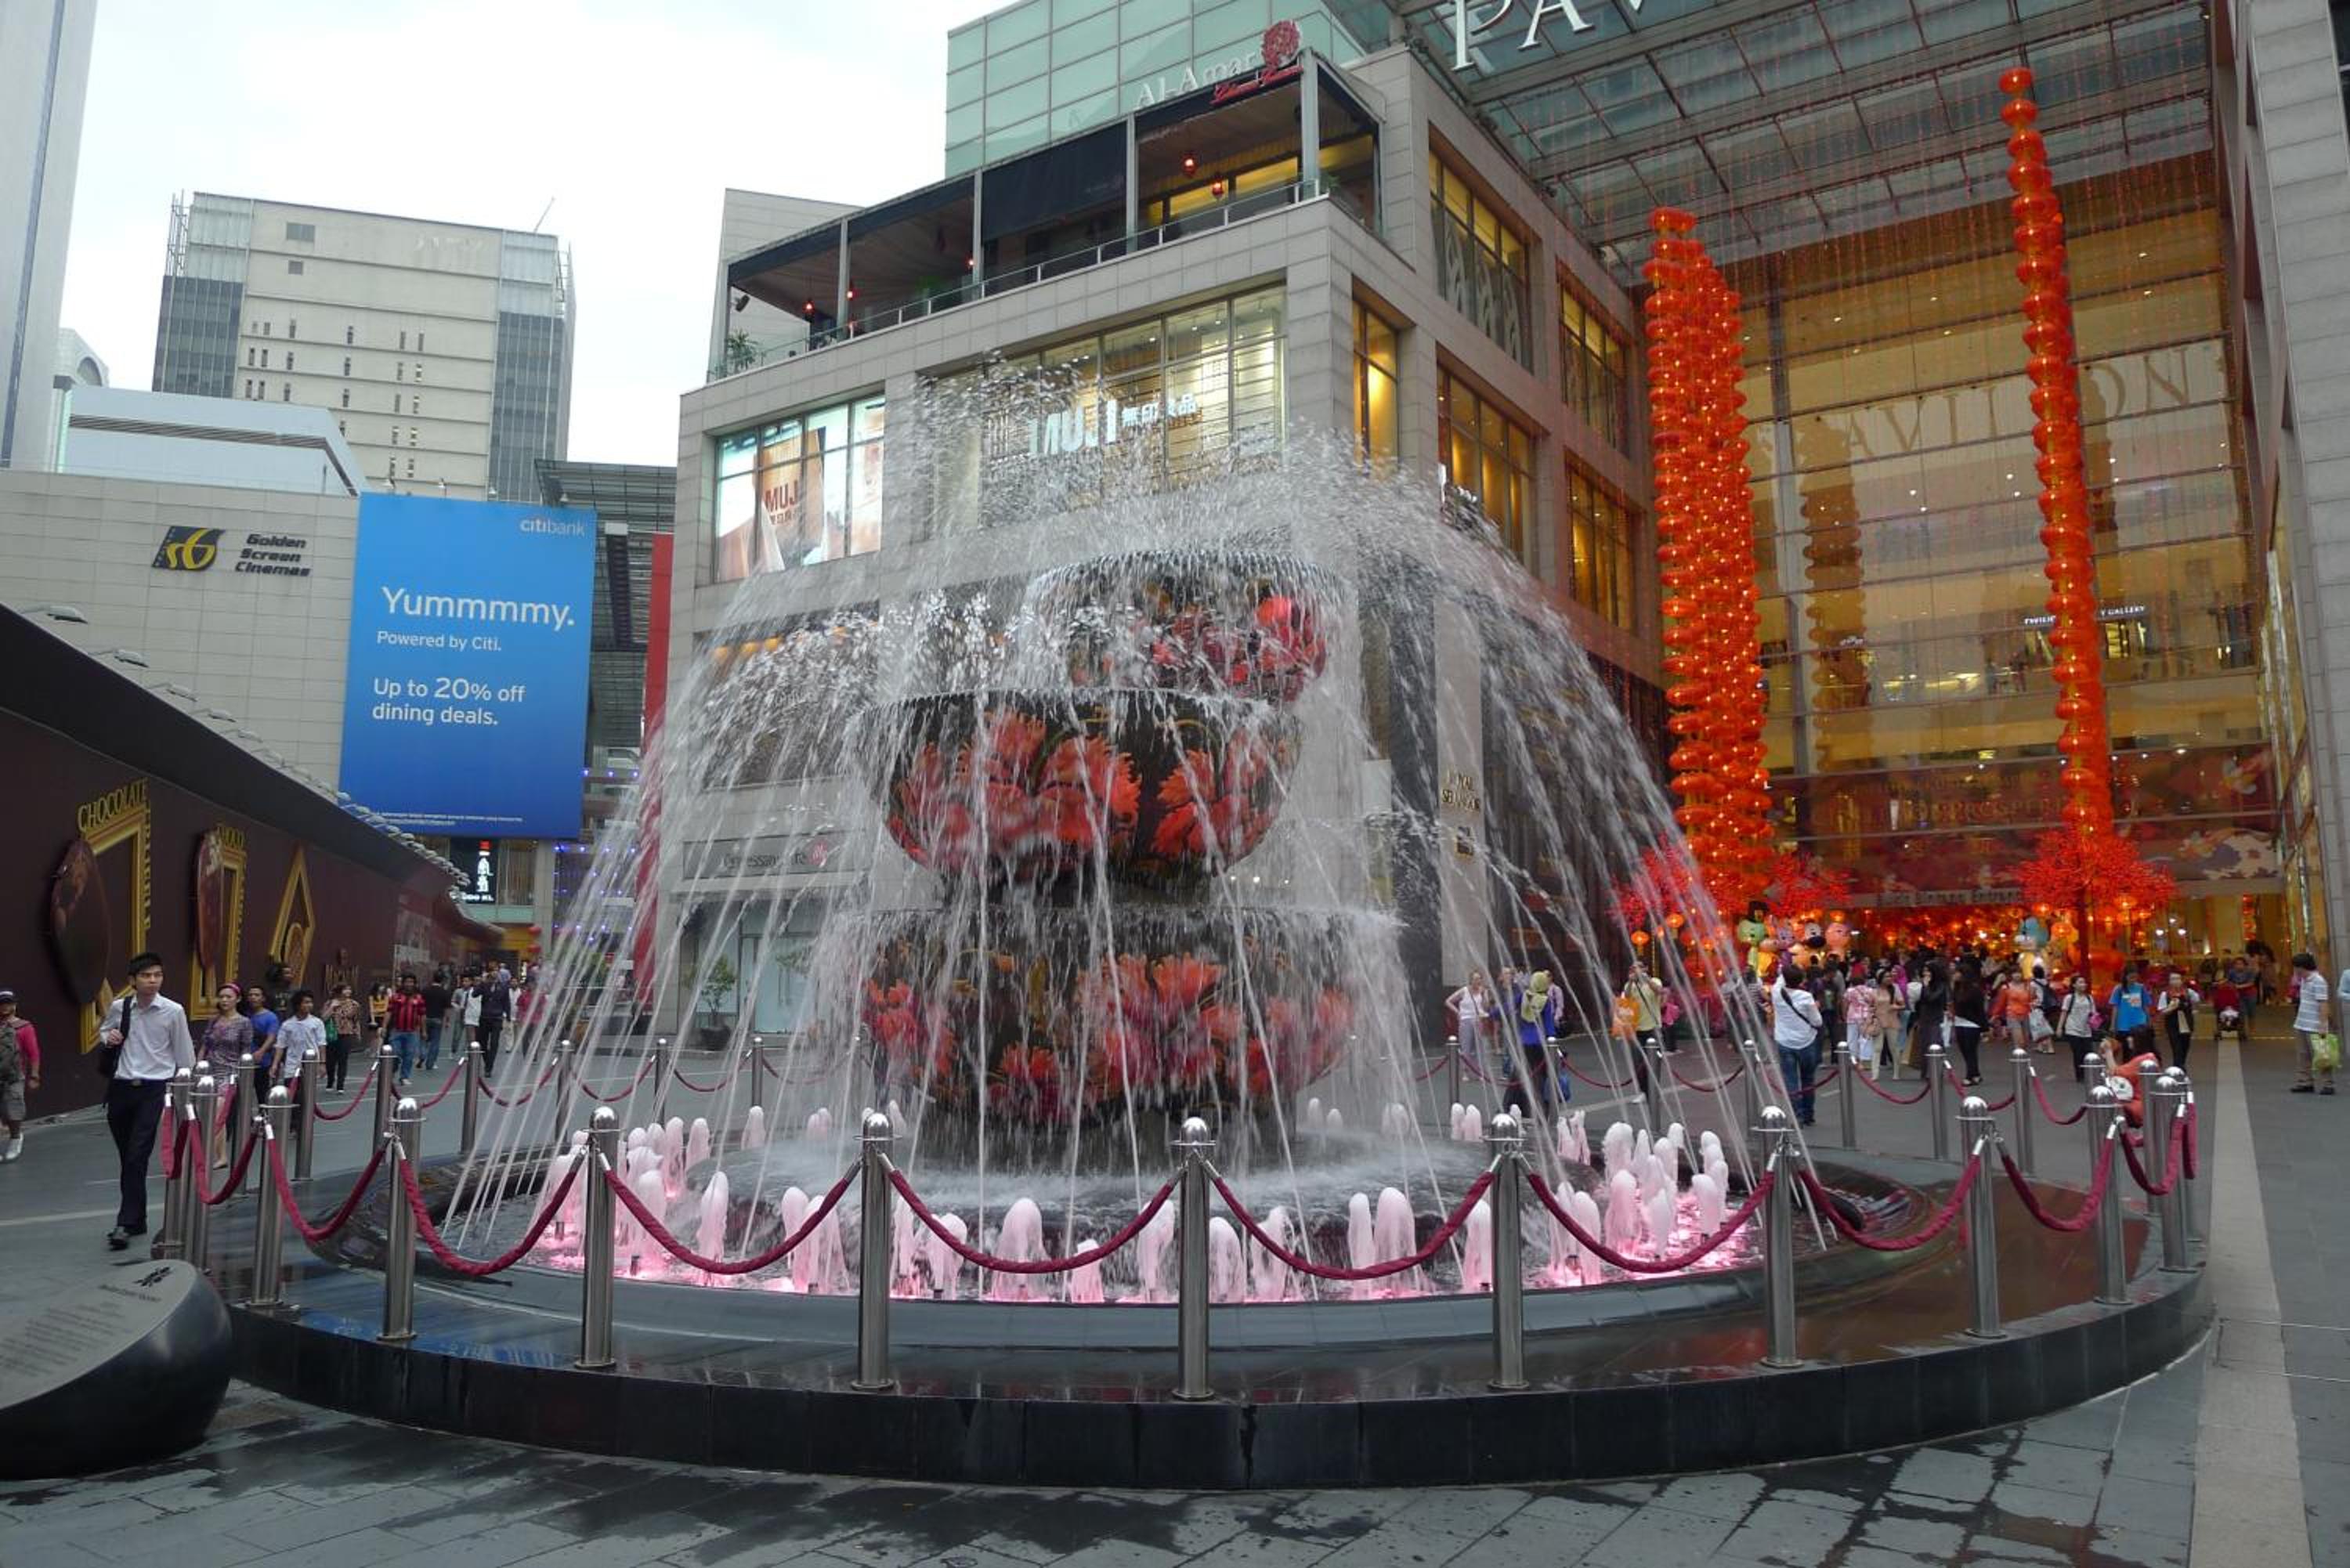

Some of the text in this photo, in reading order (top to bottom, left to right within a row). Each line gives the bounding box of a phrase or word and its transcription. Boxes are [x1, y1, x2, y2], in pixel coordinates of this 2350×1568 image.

[520, 518, 585, 537] citibank
[247, 533, 307, 549] Golden
[240, 547, 302, 562] Screen
[235, 561, 311, 577] Cinemas
[381, 586, 575, 631] Yummmmy.
[377, 630, 502, 652] Powered by Citi.
[374, 677, 526, 703] Up to 20% off
[372, 703, 498, 725] dining deals.
[78, 777, 150, 833] CHOCOLATE
